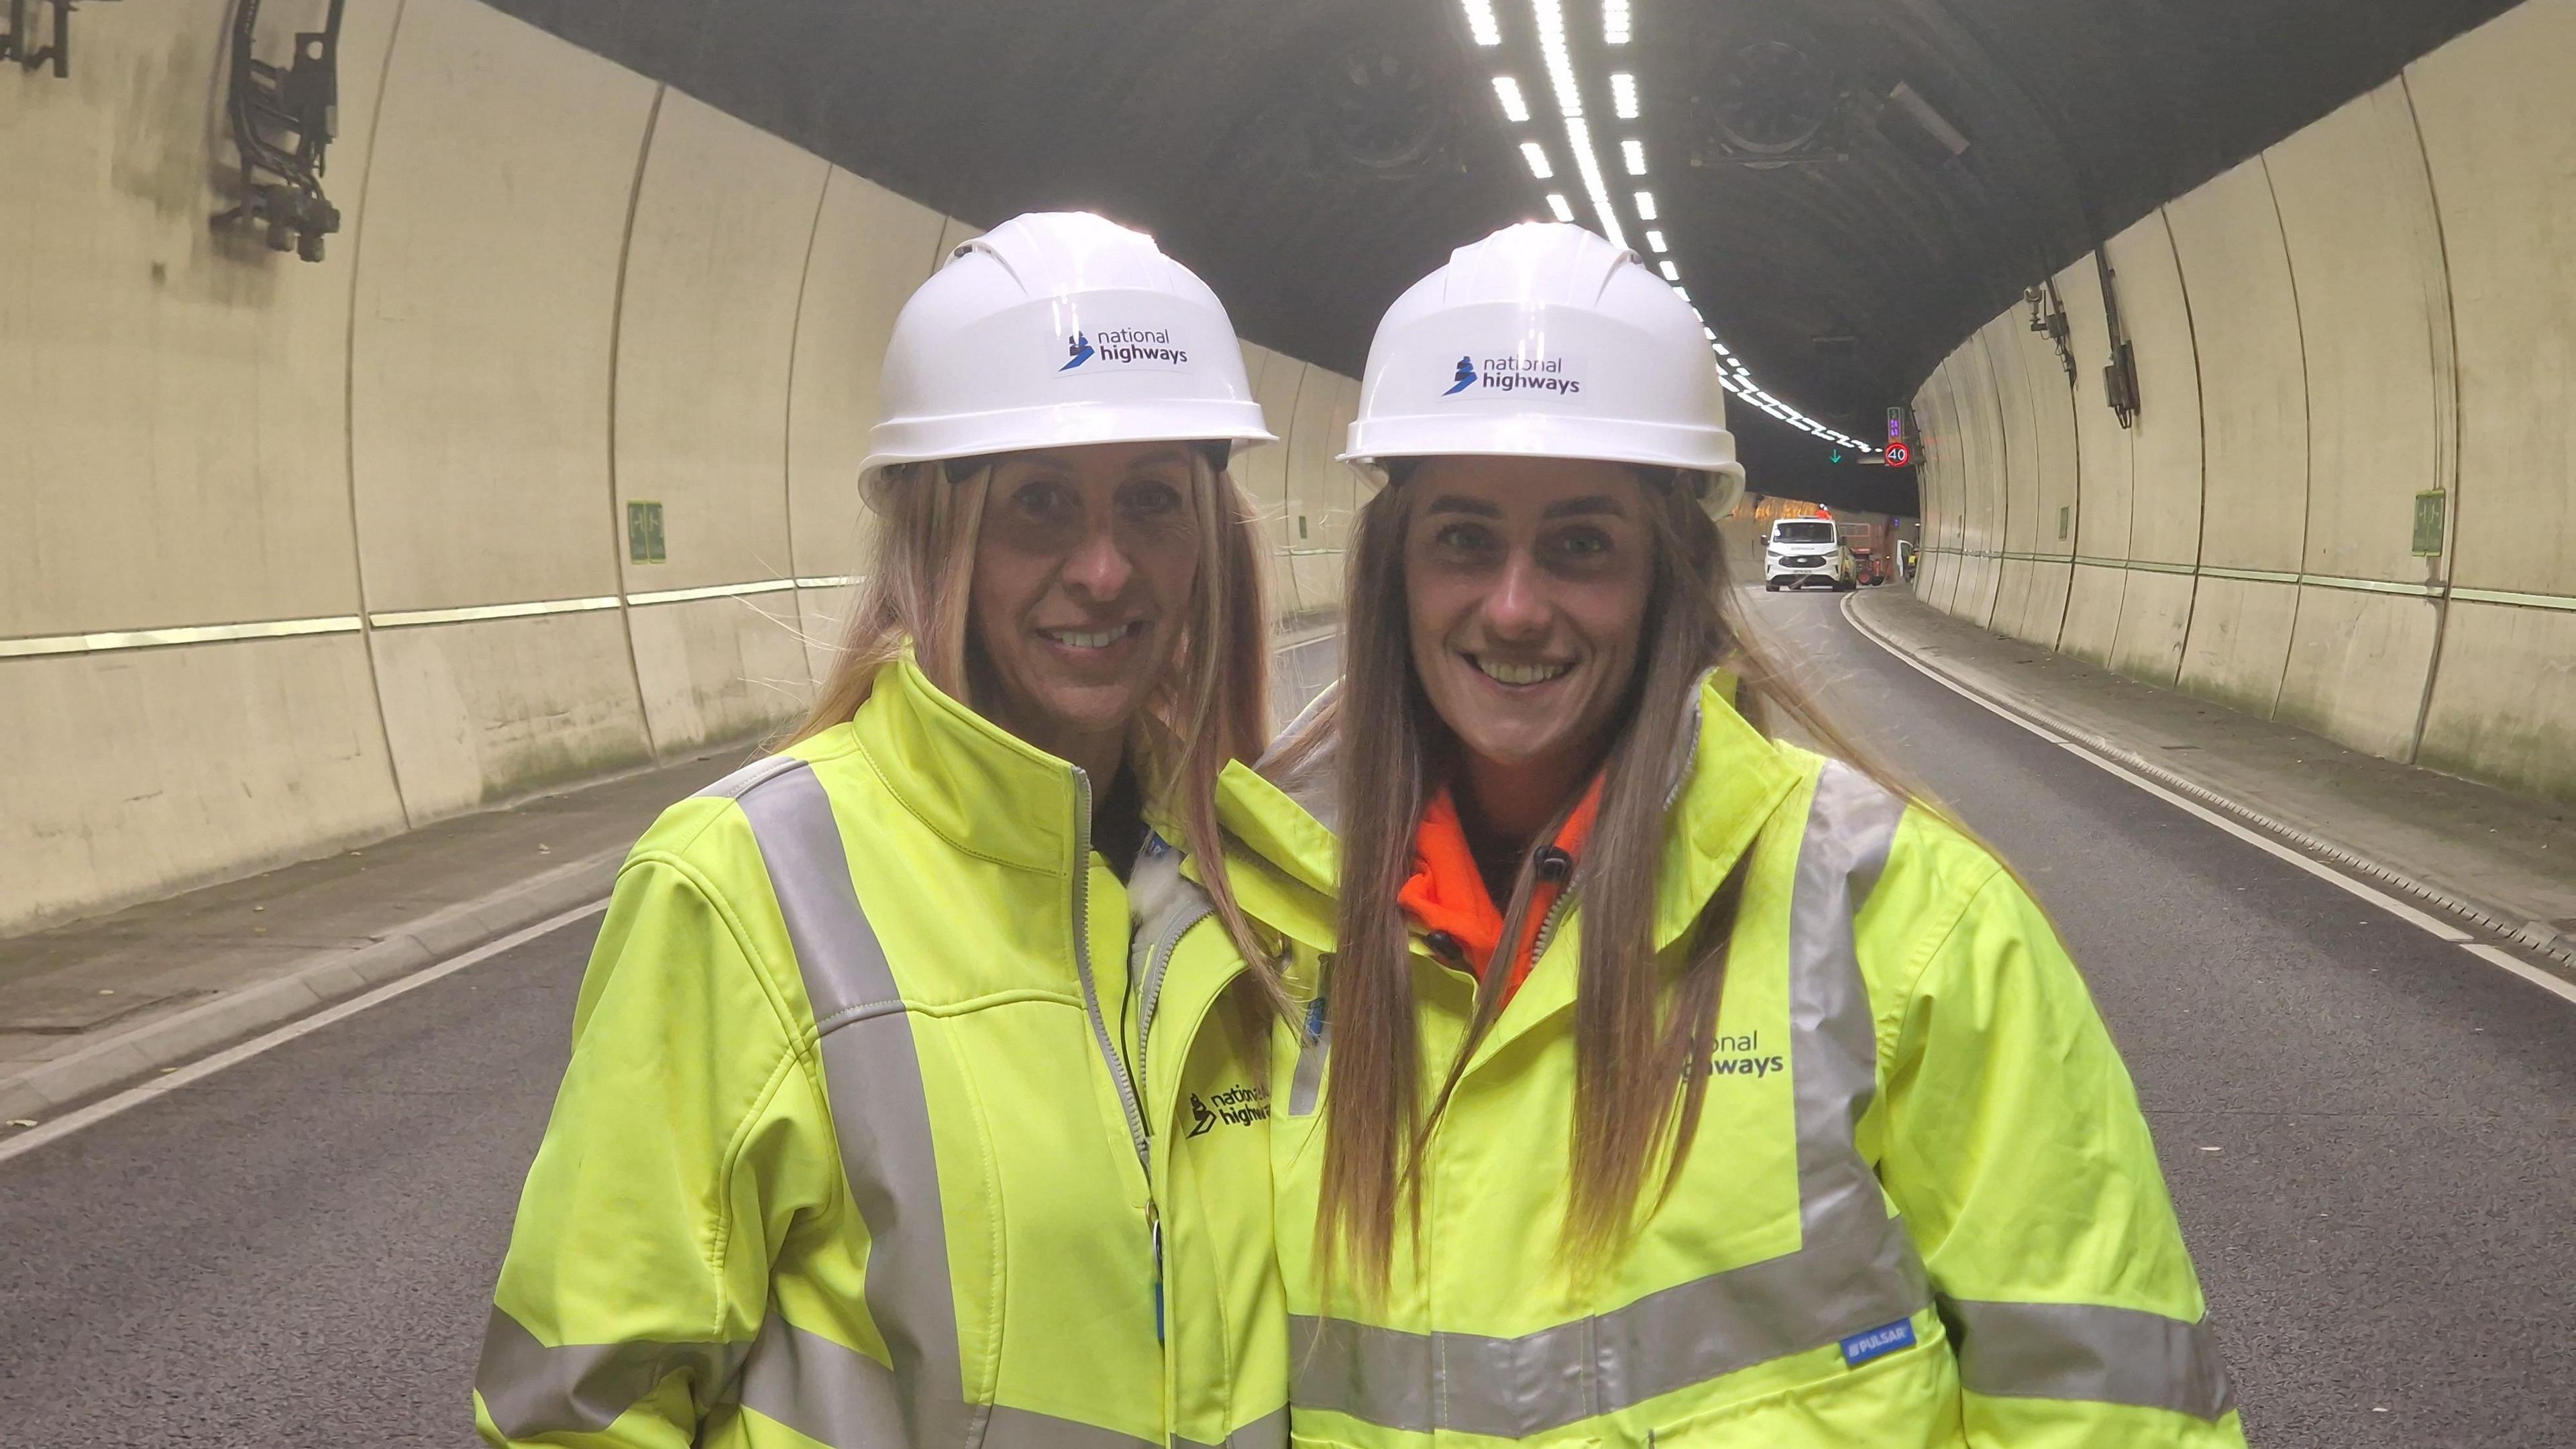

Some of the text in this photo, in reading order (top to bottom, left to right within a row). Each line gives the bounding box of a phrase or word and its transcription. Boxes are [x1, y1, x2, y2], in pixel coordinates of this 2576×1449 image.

[1098, 327, 1169, 344] national
[1099, 344, 1187, 364] highways
[1484, 356, 1562, 373] national
[1483, 372, 1580, 394] highways
[1888, 448, 1906, 460] 40
[1709, 1055, 1783, 1078] ways
[1210, 1084, 1269, 1107] nation
[1859, 1327, 1906, 1352] PULSAR
